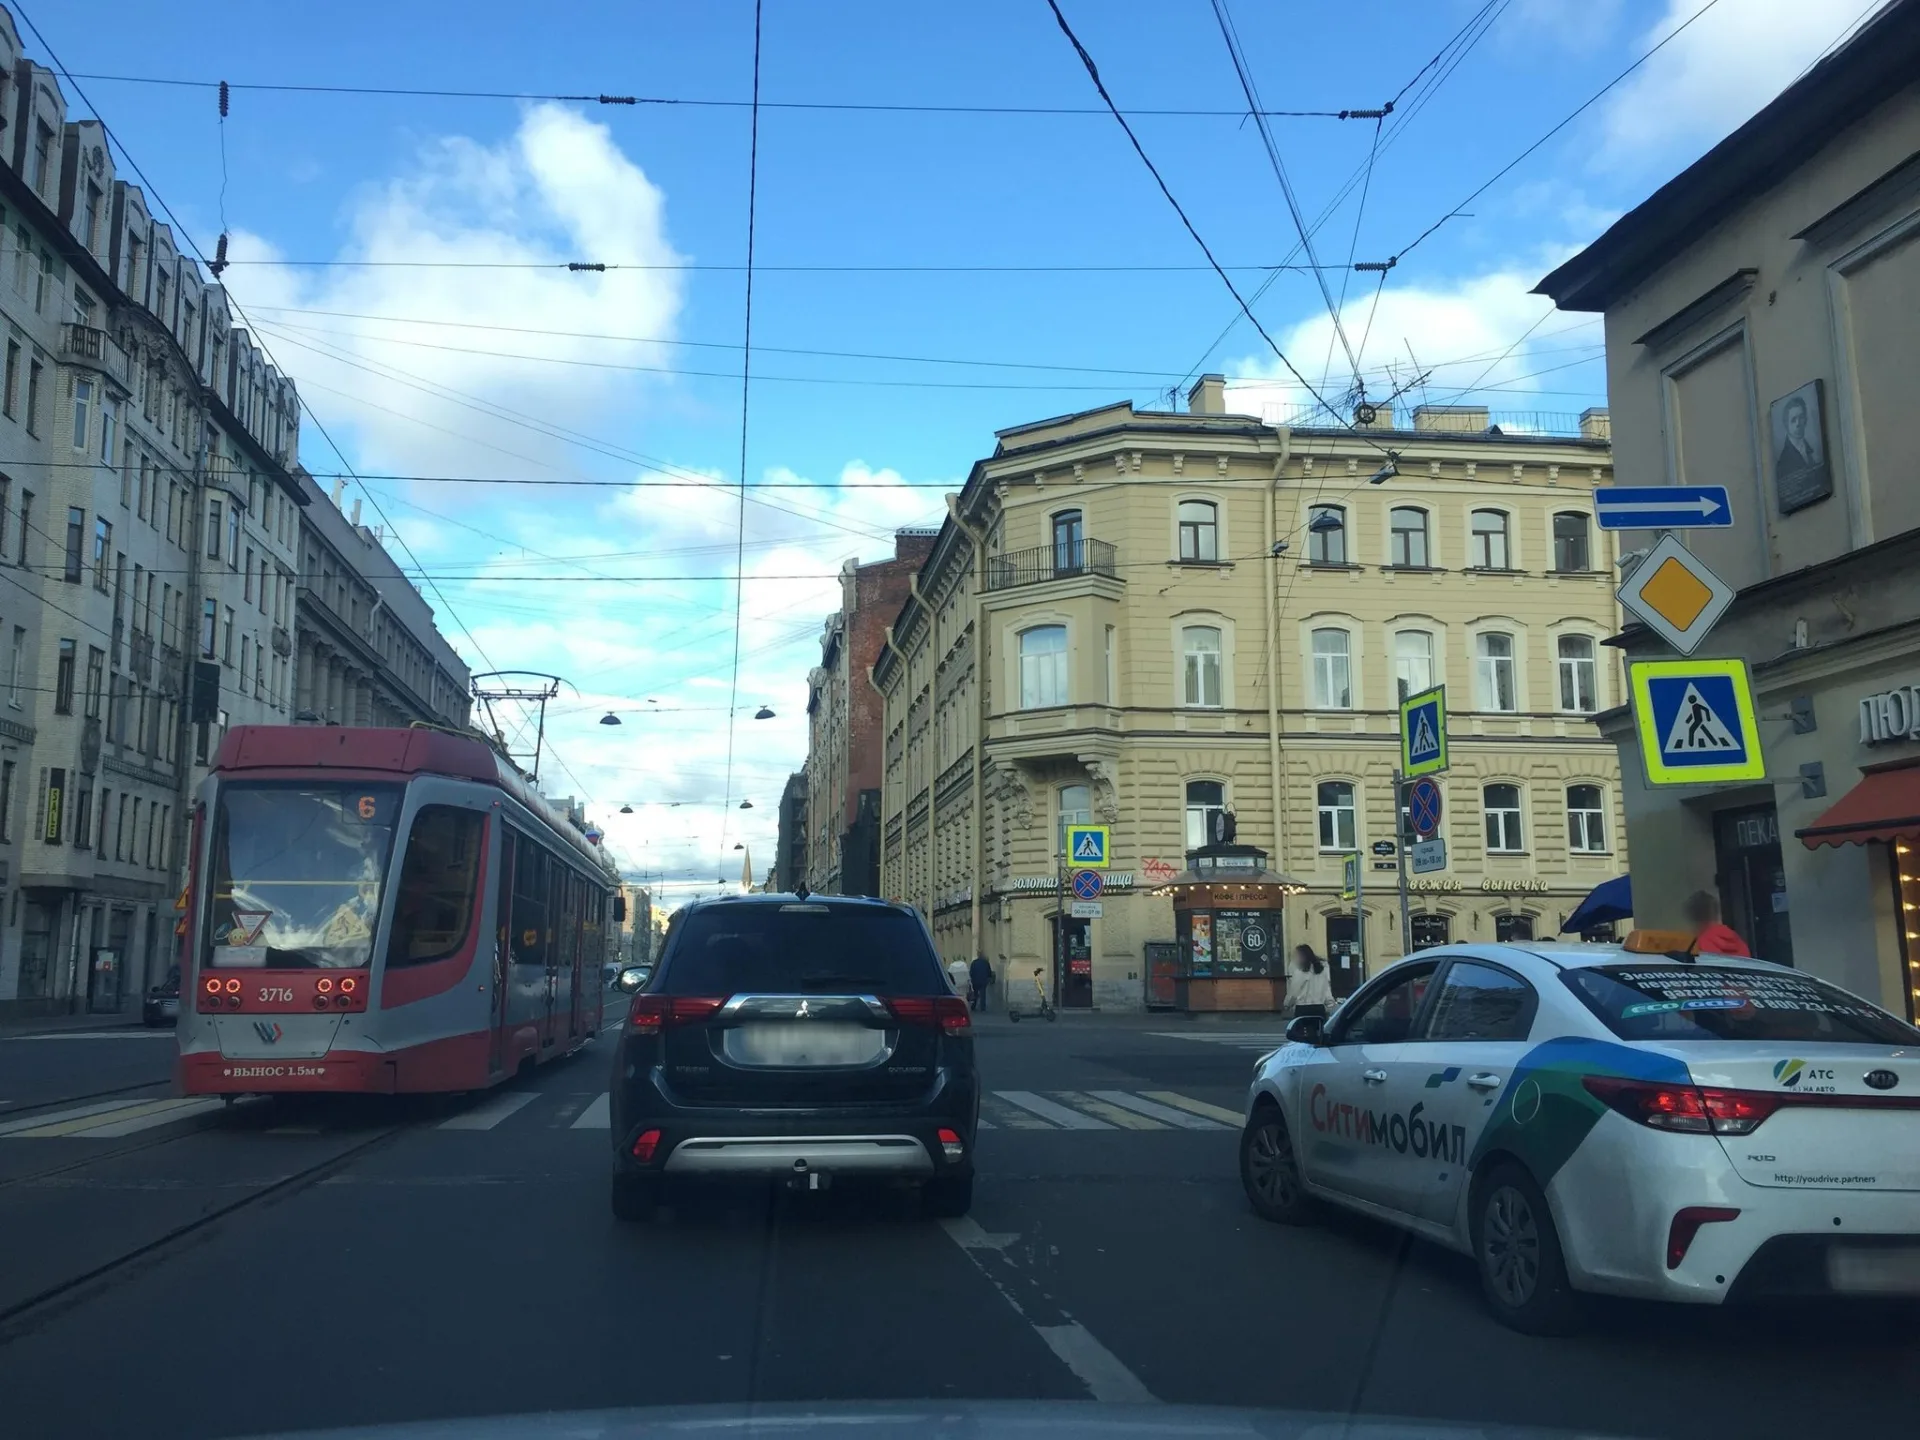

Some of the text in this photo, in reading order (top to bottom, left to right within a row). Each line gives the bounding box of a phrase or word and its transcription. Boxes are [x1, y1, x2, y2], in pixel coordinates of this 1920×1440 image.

[49, 790, 58, 836] SALE
[358, 796, 375, 819] 6
[1481, 878, 1549, 892] выпечка
[1618, 972, 1699, 981] Экономь
[258, 988, 293, 1001] 3716
[1764, 999, 1800, 1010] 800
[233, 1067, 284, 1077] ВЫНОС
[1808, 1069, 1834, 1080] АТС
[1774, 1173, 1876, 1185] http://youdrive.partners
